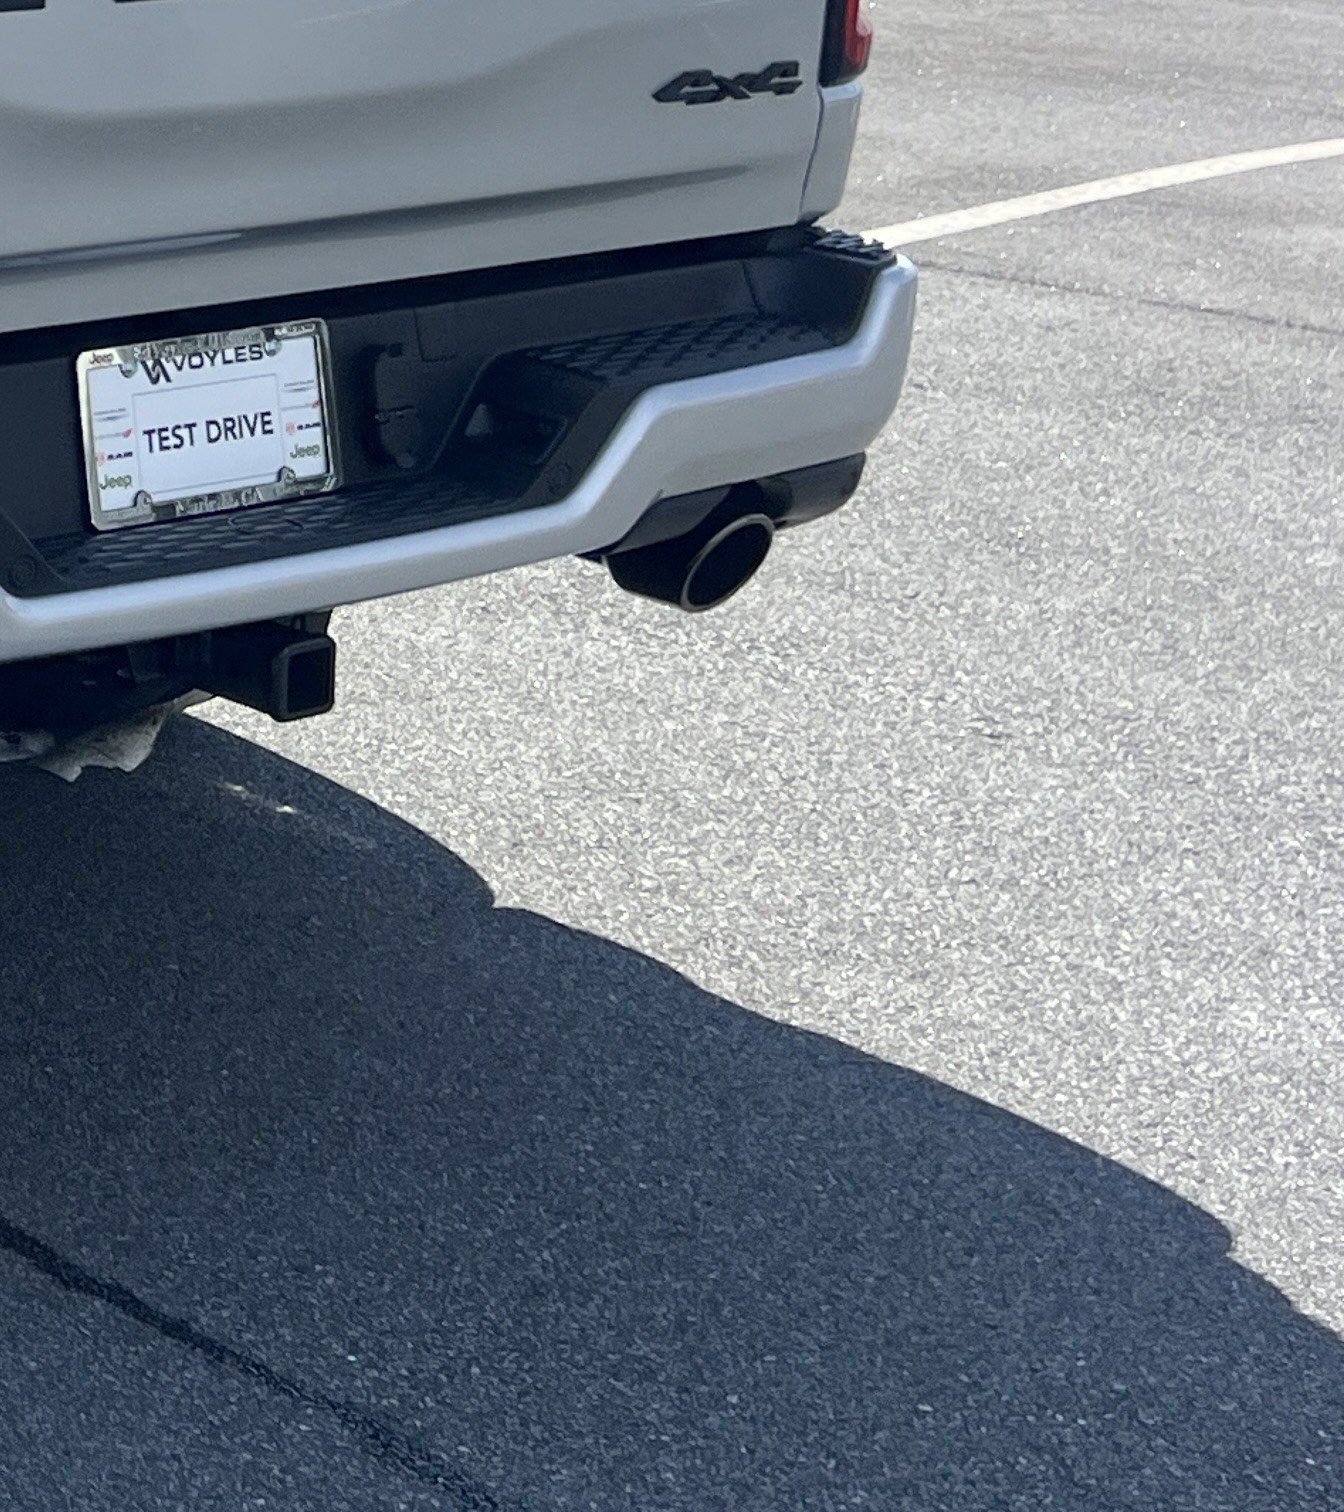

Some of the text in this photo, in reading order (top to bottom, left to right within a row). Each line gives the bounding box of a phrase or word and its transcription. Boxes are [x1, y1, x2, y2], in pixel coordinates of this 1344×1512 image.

[173, 343, 265, 372] VOYLES
[142, 410, 275, 454] TEST DRIVE
[289, 442, 321, 459] Jeep
[99, 472, 133, 491] Jeep
